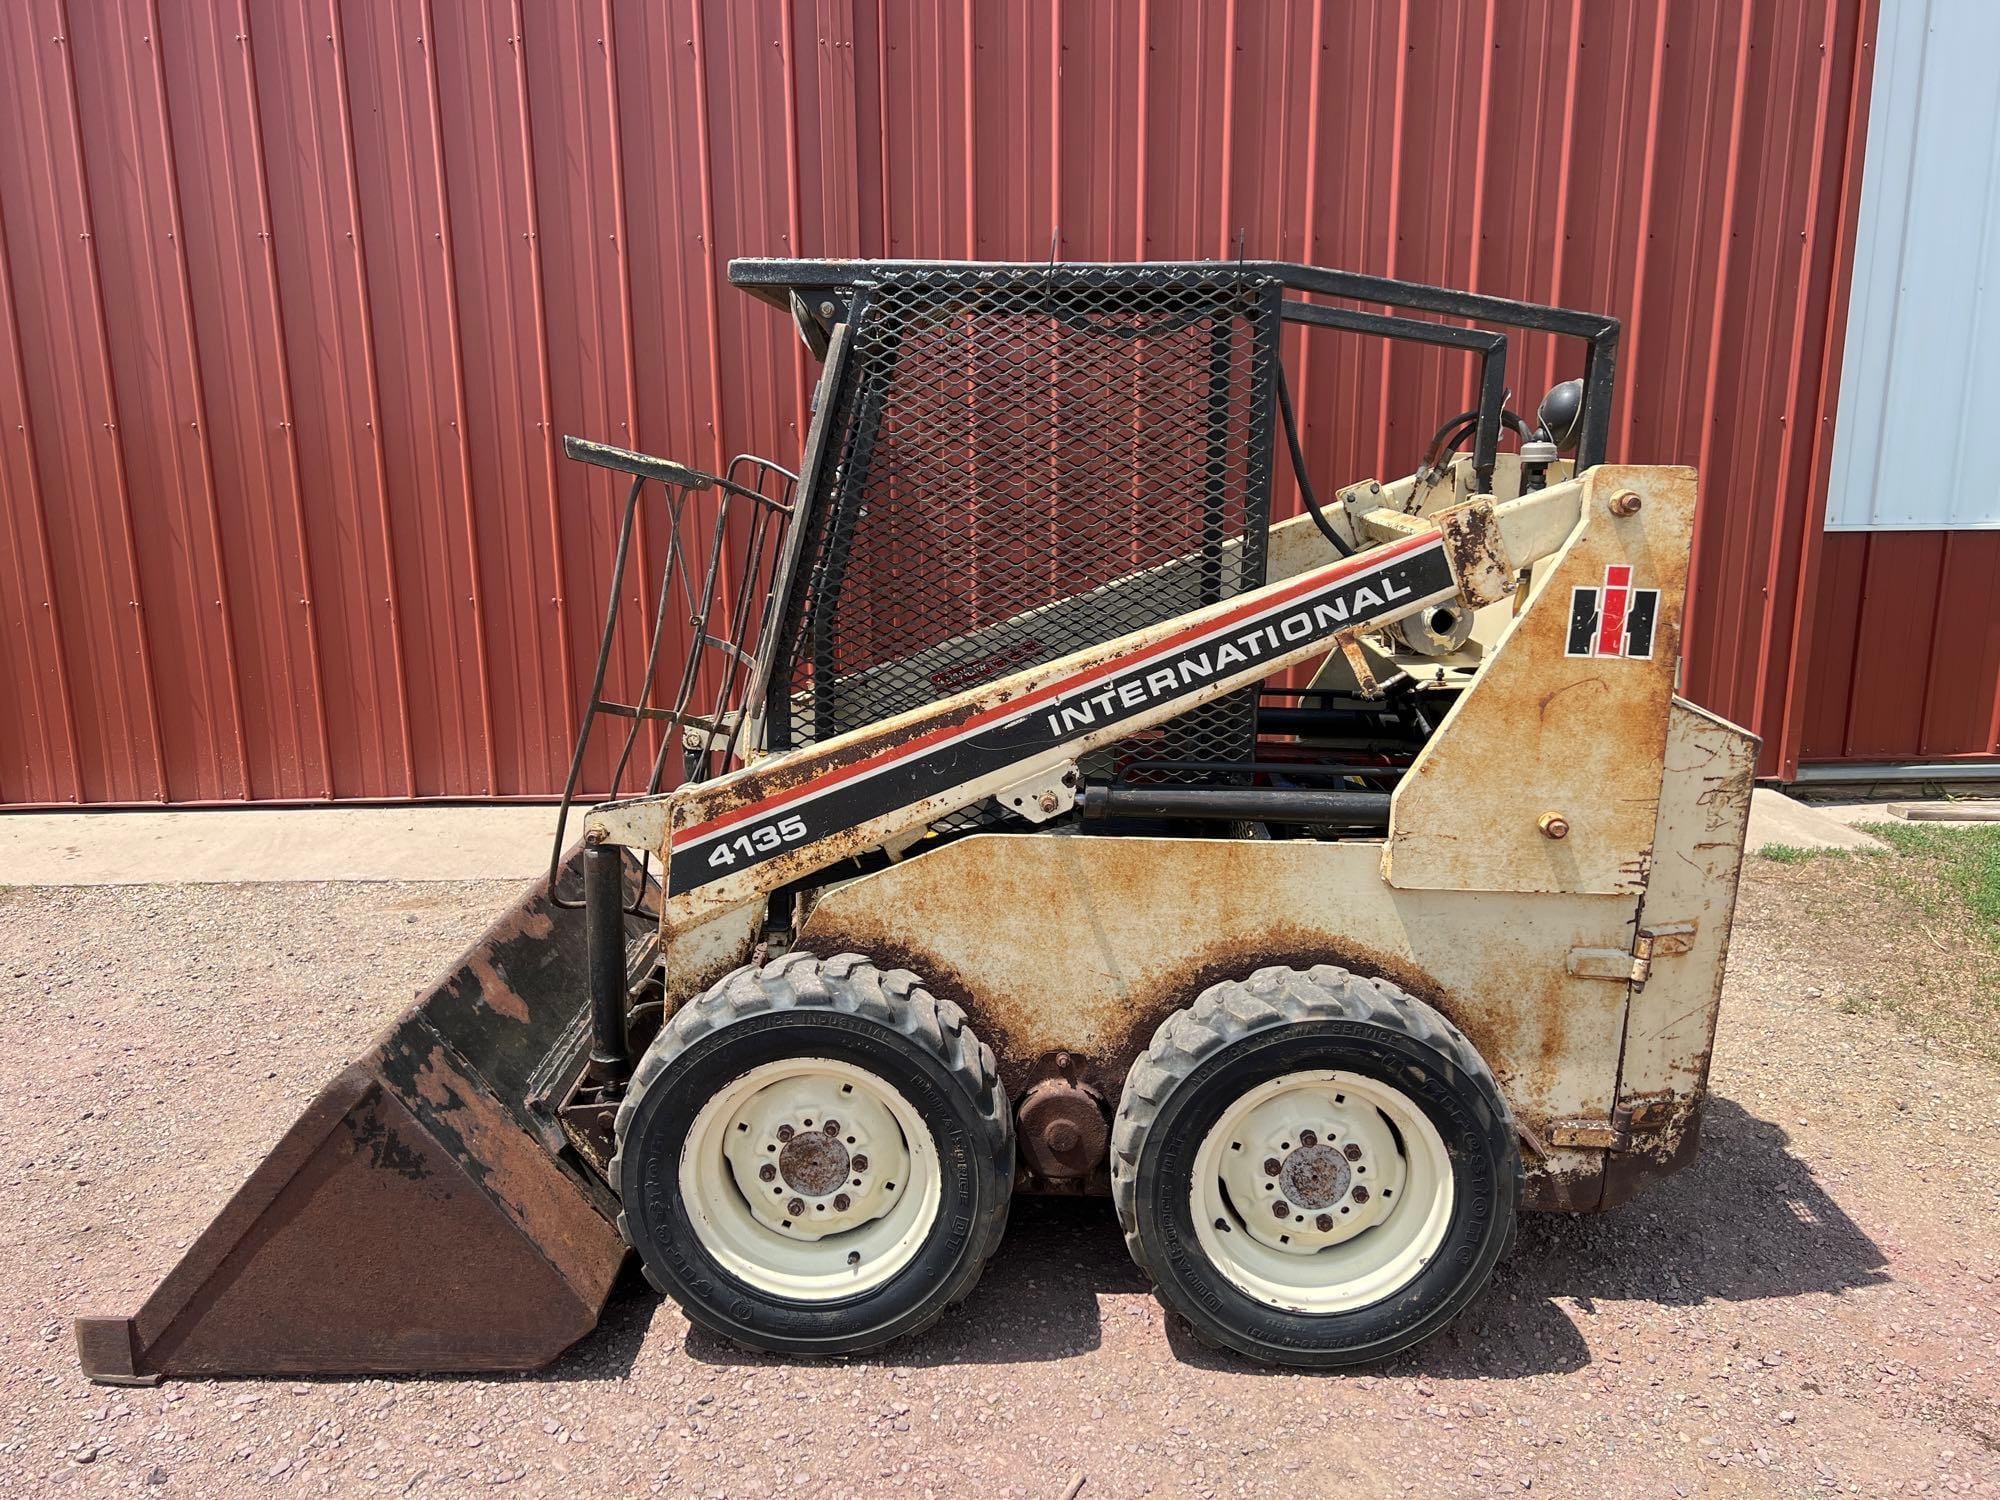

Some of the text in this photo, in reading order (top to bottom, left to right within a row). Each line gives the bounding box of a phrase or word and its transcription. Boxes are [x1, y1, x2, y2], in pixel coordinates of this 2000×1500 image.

[1047, 577, 1412, 737] INTERNATIONAL
[707, 814, 808, 868] 4135
[729, 1013, 793, 1038] SERVICE
[799, 1013, 890, 1043] INDUSTRIAL
[1221, 1041, 1250, 1064] FOR
[1330, 1023, 1399, 1043] SERVICE
[1420, 1076, 1490, 1266] Firestone
